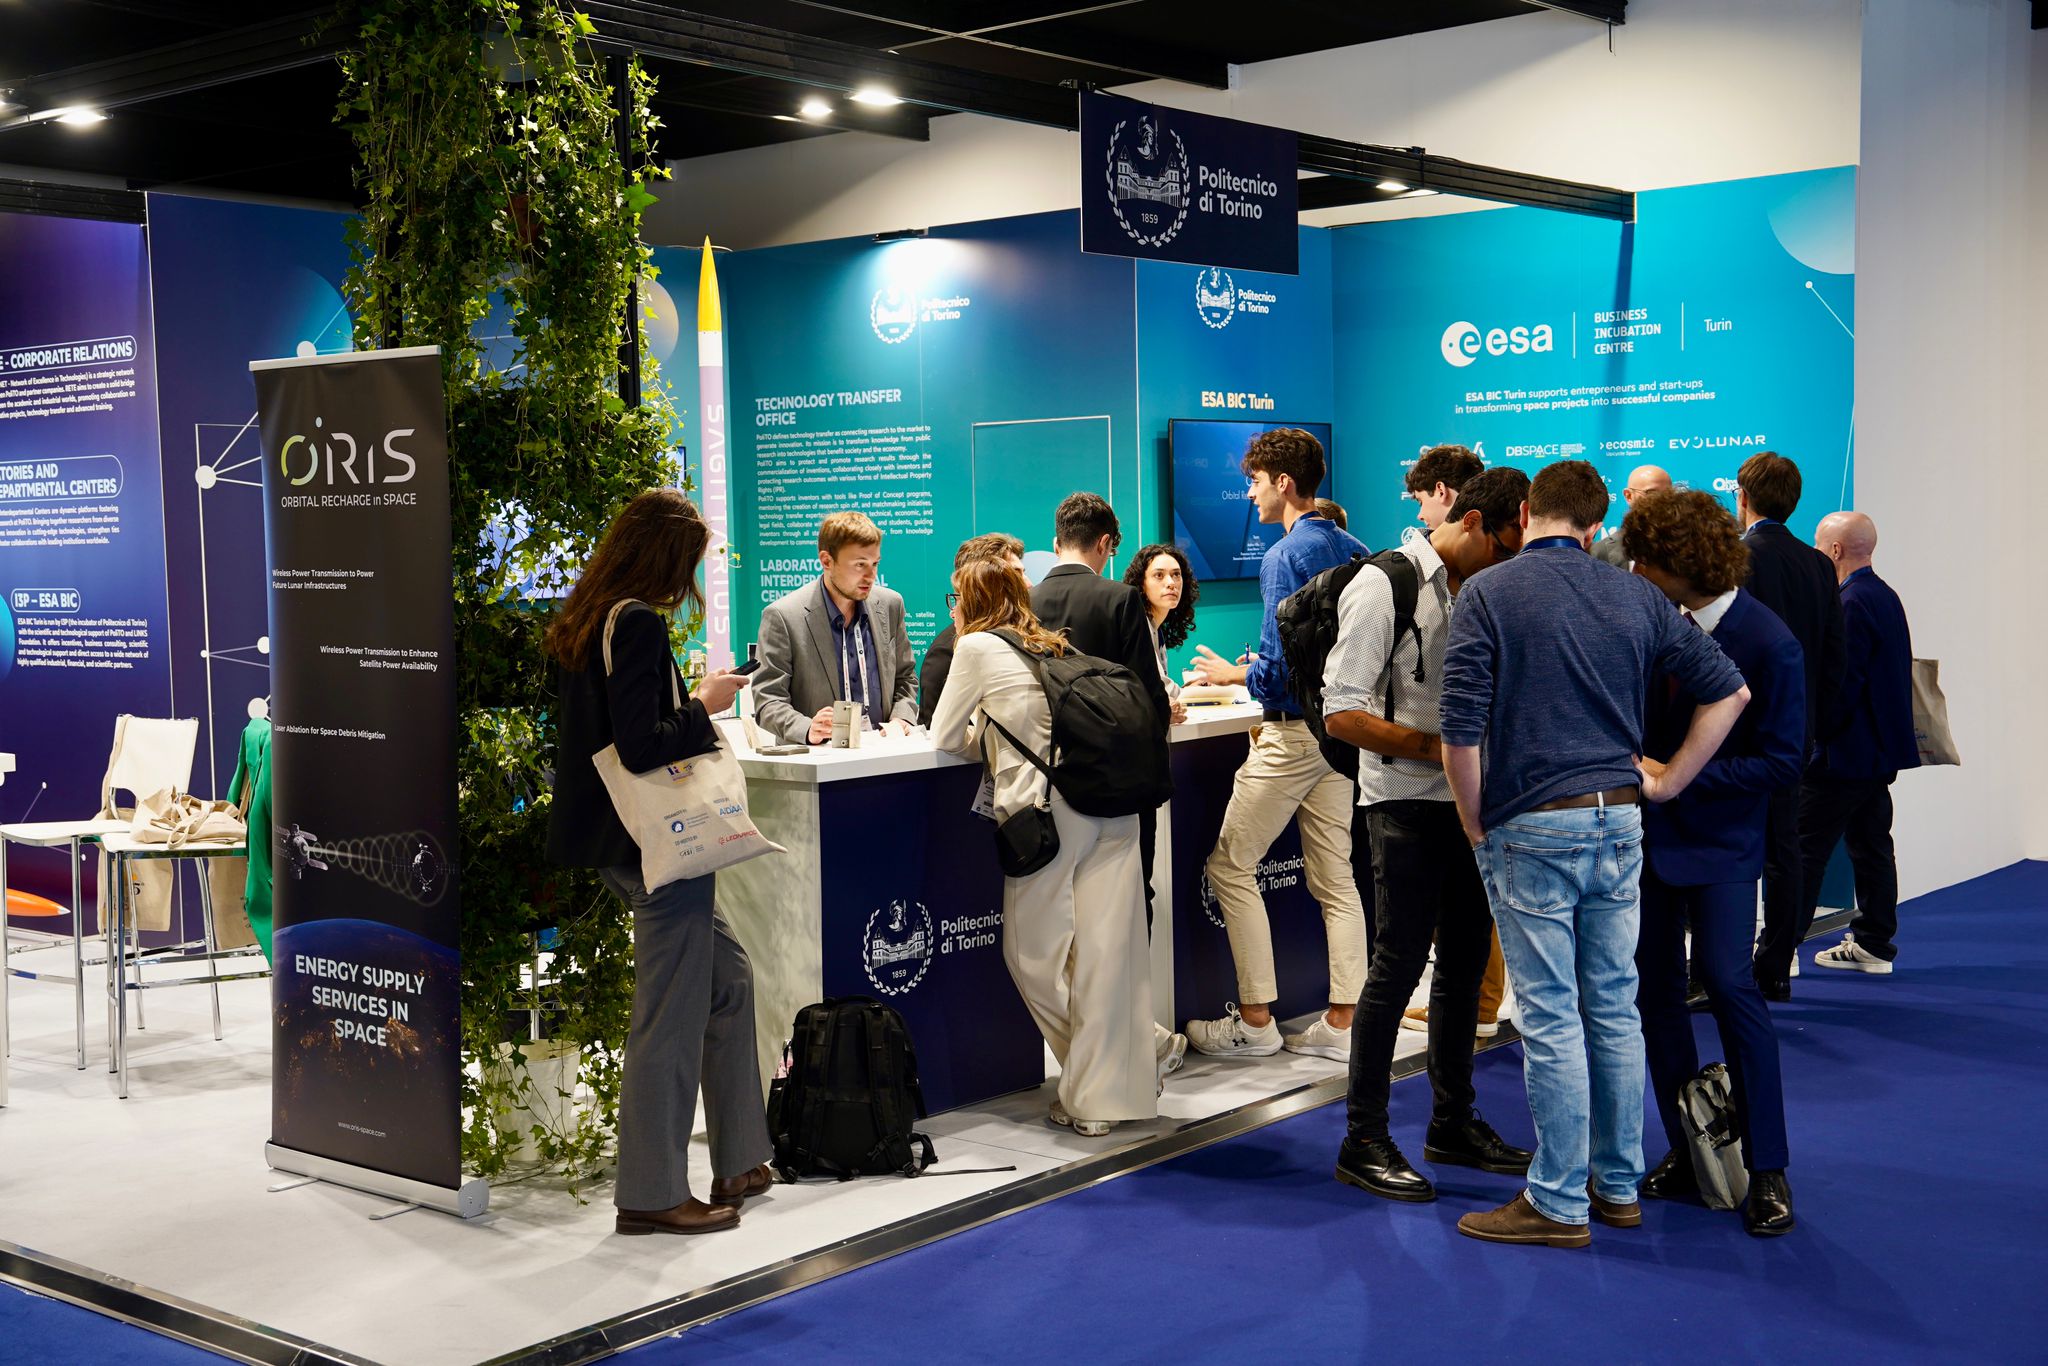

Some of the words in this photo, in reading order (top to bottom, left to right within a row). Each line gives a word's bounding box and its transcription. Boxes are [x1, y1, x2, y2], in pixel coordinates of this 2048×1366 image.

[1199, 164, 1278, 197] Politecnico
[1199, 190, 1213, 213] di
[1217, 193, 1263, 220] Torino
[1141, 212, 1159, 225] 1859
[1238, 288, 1276, 303] Politecnico
[932, 308, 961, 321] Torino
[1238, 301, 1246, 312] di
[1247, 301, 1269, 314] Torino
[1594, 308, 1648, 324] BUSINESS
[1594, 323, 1661, 339] INCUBATION
[1704, 317, 1732, 332] Turin
[1485, 323, 1553, 356] esa
[10, 347, 72, 369] CORPORATE
[73, 341, 133, 362] RELATIONS
[1594, 341, 1634, 355] CENTRE
[1466, 392, 1484, 402] ESA
[1486, 390, 1502, 401] BIC
[1504, 389, 1527, 400] Turin
[1528, 387, 1568, 400] supports
[1570, 382, 1636, 396] entrepreneurs
[1638, 379, 1657, 391] and
[1659, 378, 1703, 392] start-ups
[755, 393, 835, 411] TECHNOLOGY
[836, 388, 902, 405] TRANSFER
[1201, 391, 1225, 408] ESA
[1227, 392, 1246, 409] BIC
[1247, 393, 1274, 410] Turin
[1455, 404, 1464, 414] in
[1465, 401, 1522, 415] transforming
[1523, 400, 1549, 412] space
[1551, 397, 1589, 410] projects
[1591, 395, 1609, 406] into
[1611, 392, 1661, 405] successful
[1662, 390, 1716, 404] companies
[755, 412, 796, 427] OFFICE
[841, 428, 867, 436] connecting
[868, 426, 889, 434] research
[1606, 437, 1654, 450] ecosmic
[1669, 435, 1766, 449] EVOLUNAR
[899, 453, 919, 461] through
[1505, 443, 1560, 457] DBSPACE
[35, 463, 59, 479] AND
[832, 465, 863, 473] collaborating
[880, 472, 909, 480] Intellectual
[909, 472, 932, 480] Property
[69, 478, 117, 495] CENTERS
[281, 495, 319, 508] ORBITAL
[321, 494, 371, 507] RECHARGE
[373, 495, 381, 505] in
[383, 493, 416, 505] SPACE
[858, 491, 873, 499] Proof
[882, 491, 904, 499] Concept
[906, 491, 932, 499] programs,
[707, 403, 730, 635] SAGITTARIUS
[760, 558, 823, 572] LABORATO
[272, 569, 291, 577] Wireless
[292, 569, 310, 577] Power
[311, 569, 349, 578] Transmission
[356, 570, 374, 578] Power
[272, 581, 287, 589] Future
[287, 581, 303, 589] Lunar
[304, 581, 347, 590] Infrastructures
[14, 593, 30, 608] I3P
[39, 593, 60, 608] ESA
[60, 593, 78, 608] BIC
[320, 645, 345, 654] Wireless
[345, 646, 363, 655] Power
[364, 647, 400, 657] Transmission
[401, 649, 408, 657] to
[408, 649, 438, 658] Enhance
[359, 659, 382, 668] Satellite
[382, 661, 400, 669] Power
[401, 661, 438, 673] Availability
[286, 725, 310, 734] Ablation
[310, 726, 319, 735] for
[320, 727, 338, 737] Space
[338, 728, 357, 738] Debris
[357, 730, 386, 741] Mitigation
[1258, 878, 1266, 892] di
[1268, 873, 1297, 890] Torino
[941, 942, 953, 954] di
[956, 932, 996, 951] Torino
[295, 954, 360, 983] ENERGY
[362, 965, 425, 995] SUPPLY
[892, 969, 907, 979] 1859
[312, 985, 388, 1018] SERVICES
[392, 1000, 409, 1022] IN
[335, 1018, 388, 1047] SPACE
